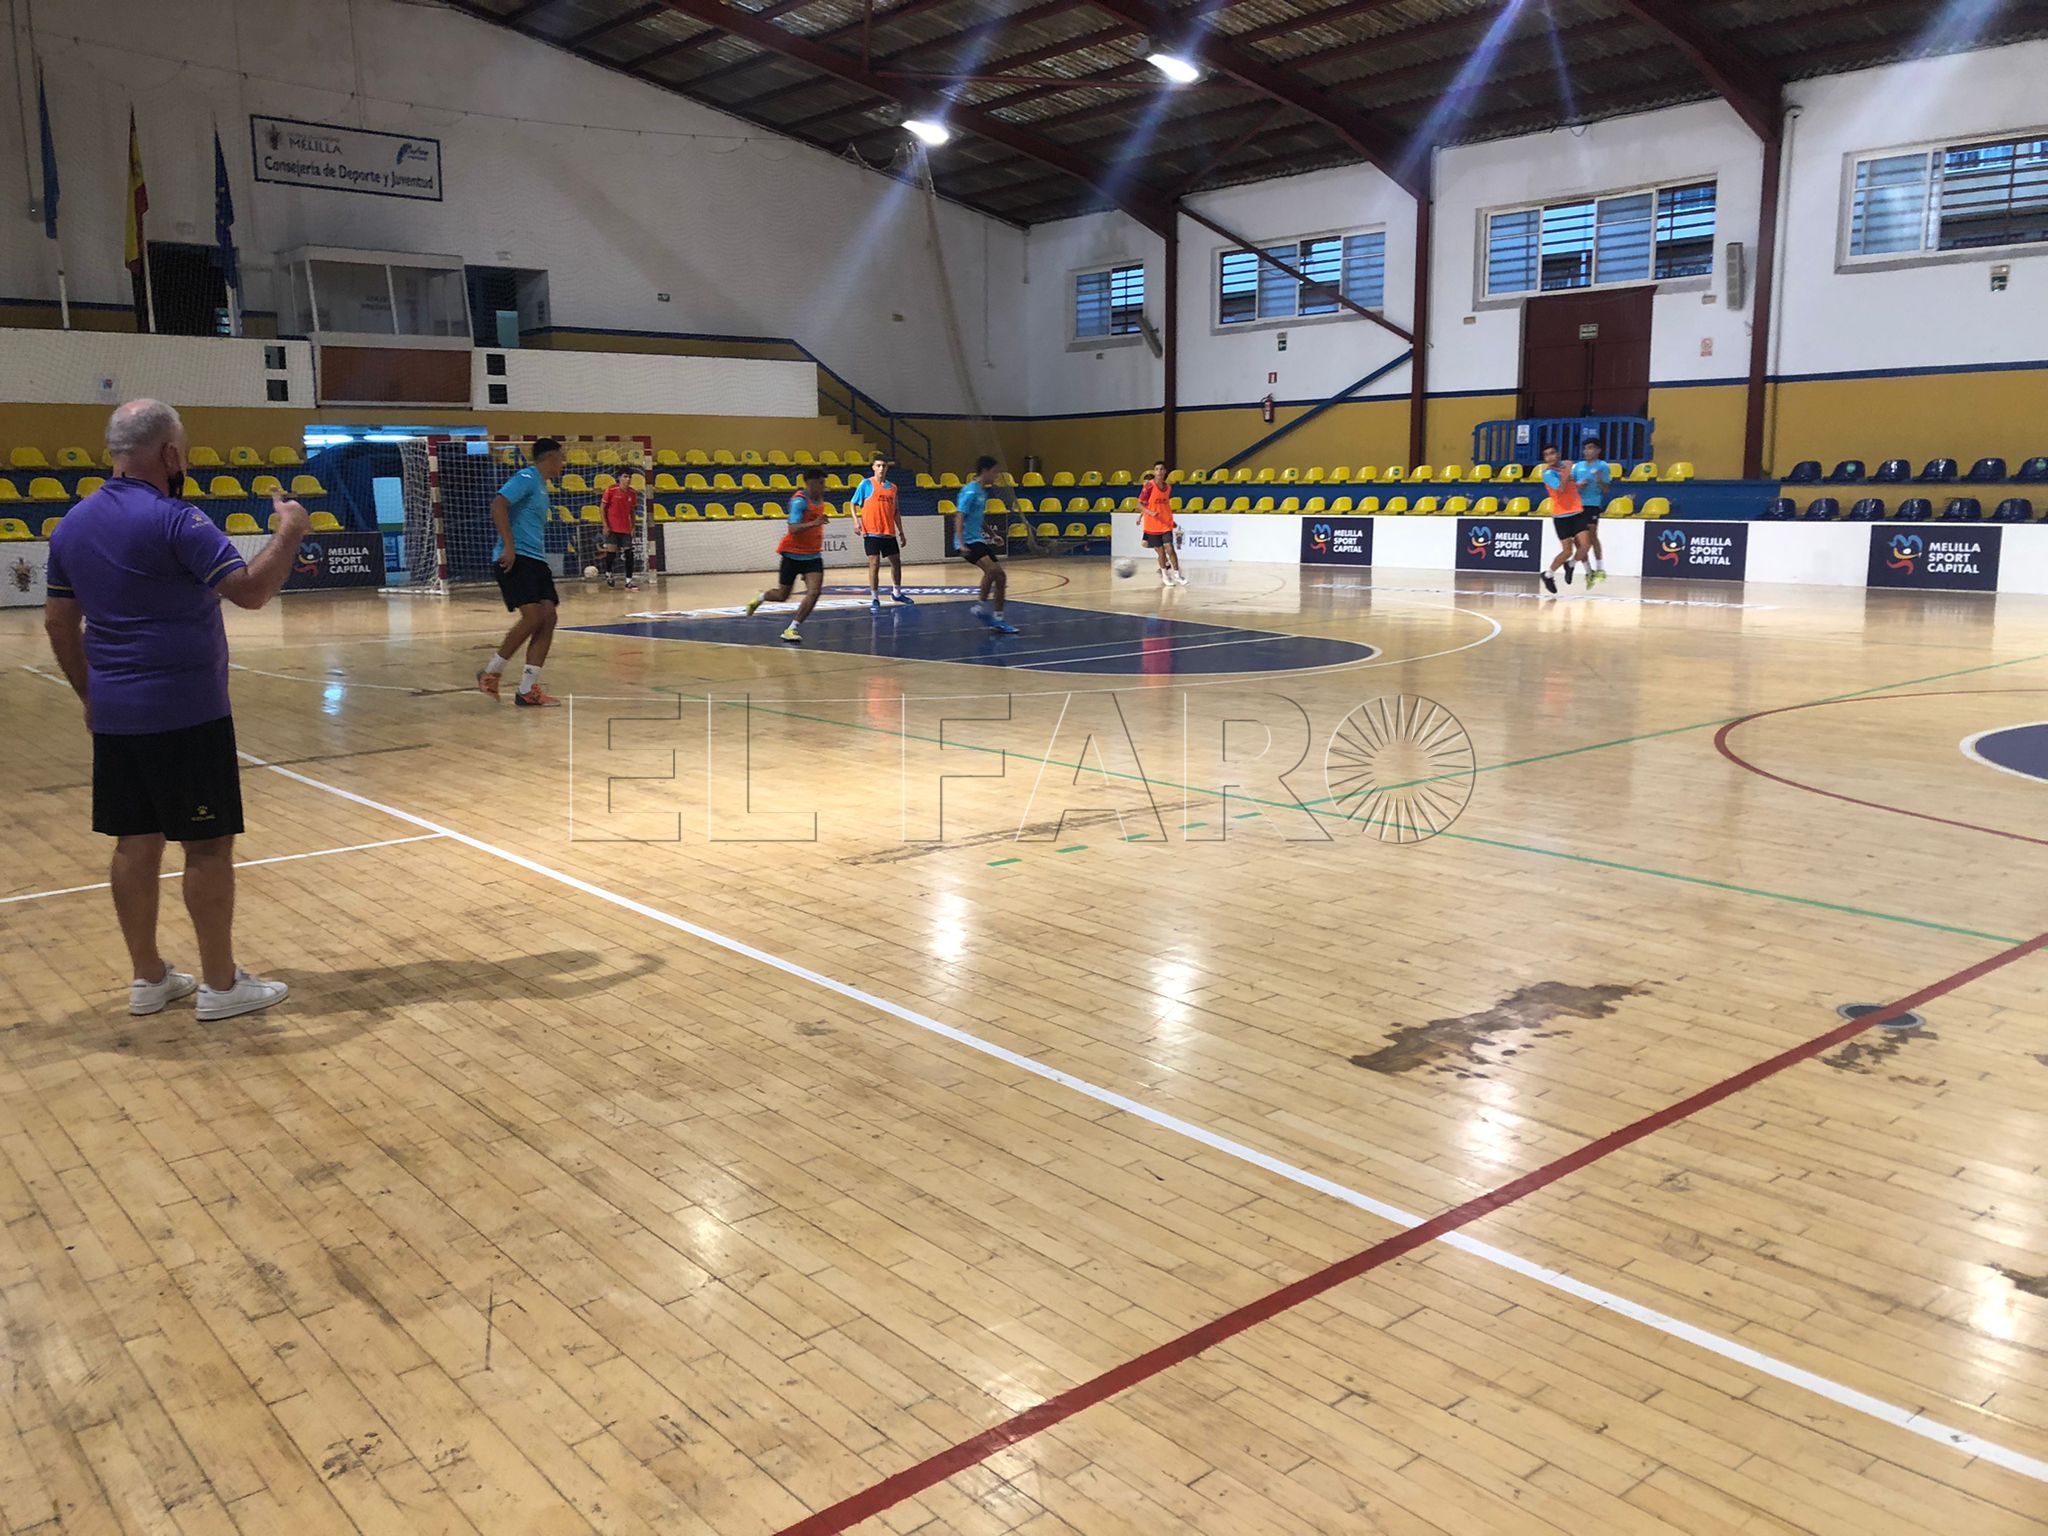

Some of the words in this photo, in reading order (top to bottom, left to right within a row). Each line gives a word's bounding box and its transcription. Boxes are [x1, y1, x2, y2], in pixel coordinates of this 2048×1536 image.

[288, 137, 343, 155] MELILLA
[322, 163, 337, 179] de
[339, 165, 381, 184] Deporte
[383, 174, 390, 187] y
[391, 171, 433, 189] Juventud
[1494, 533, 1529, 541] MELILLA
[1690, 537, 1732, 546] MELILLA
[824, 541, 848, 552] ILLA
[1189, 536, 1229, 548] MELILLA
[1494, 541, 1522, 549] SPORT
[328, 547, 369, 555] MELILLA
[1332, 545, 1363, 553] CAPITAL
[1690, 546, 1724, 555] SPORT
[1928, 542, 1981, 552] MELILLA
[1493, 550, 1529, 558] CAPITAL
[1928, 553, 1971, 562] SPORT
[328, 556, 361, 565] SPORT
[1688, 555, 1731, 565] CAPITAL
[329, 565, 371, 574] CAPITAL
[1927, 563, 1980, 573] CAPITAL
